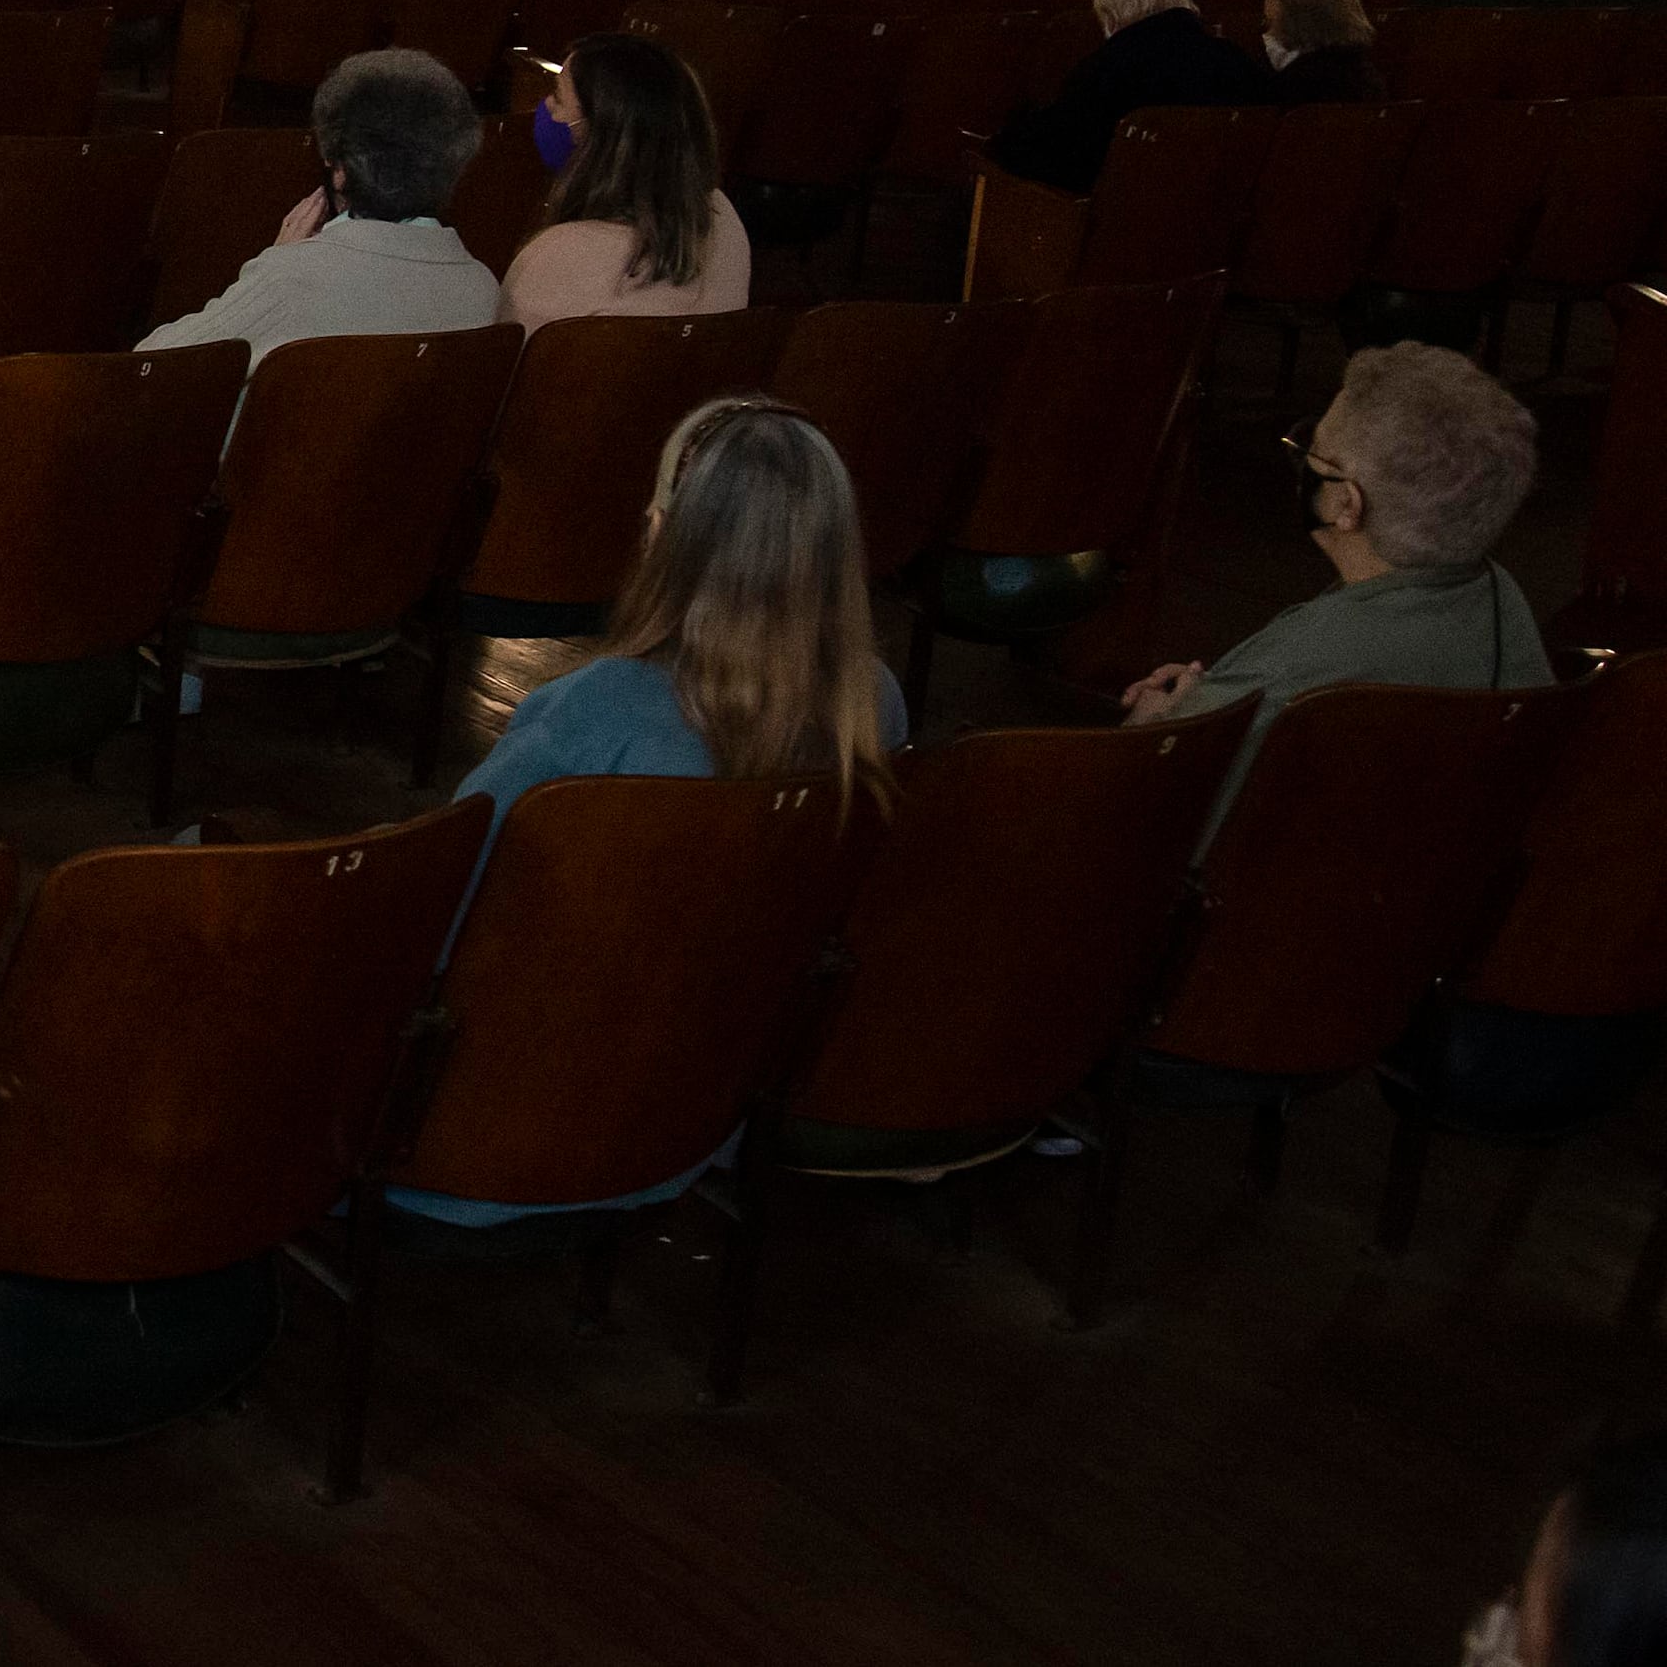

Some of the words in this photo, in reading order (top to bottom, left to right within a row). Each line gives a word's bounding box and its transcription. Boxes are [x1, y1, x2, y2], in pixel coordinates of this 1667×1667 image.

[1158, 735, 1177, 755] 9
[773, 788, 809, 811] 11
[327, 850, 364, 877] 13
